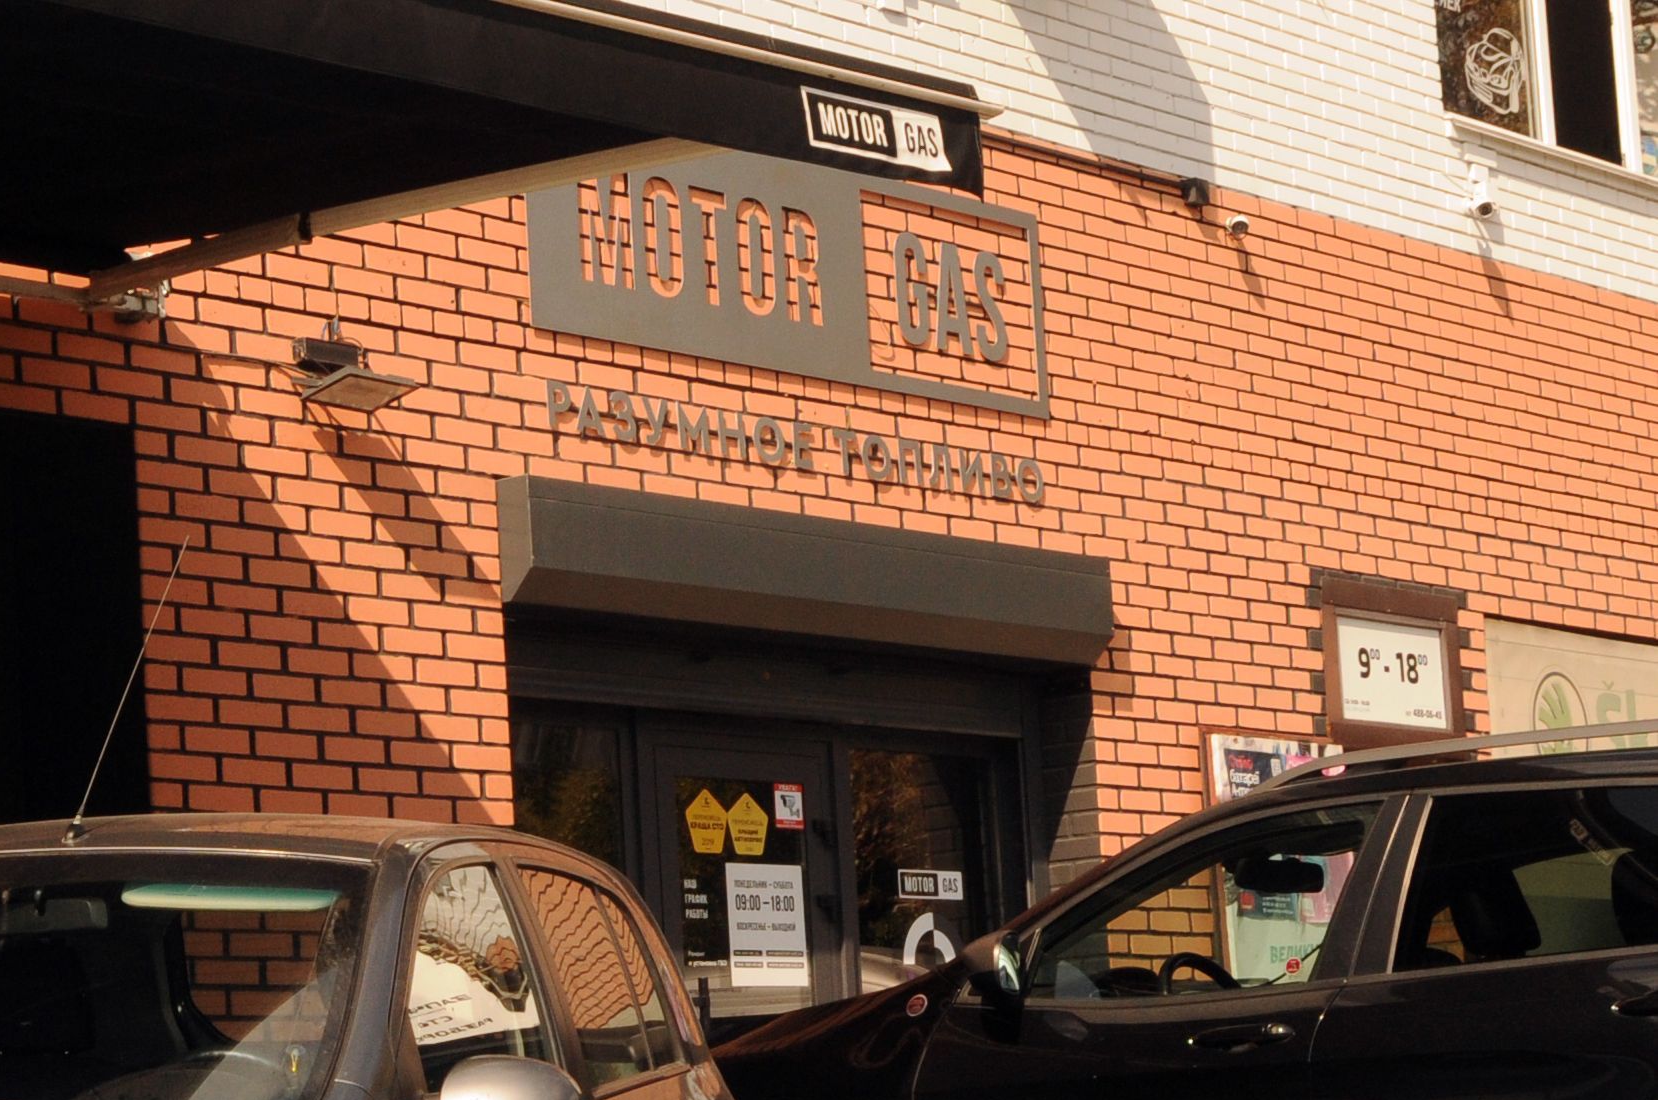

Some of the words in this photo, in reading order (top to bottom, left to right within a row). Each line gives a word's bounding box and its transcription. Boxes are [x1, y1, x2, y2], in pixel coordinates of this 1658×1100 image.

[817, 102, 888, 148] MOTOR
[904, 122, 939, 159] GAS
[576, 172, 824, 328] MOTOR
[893, 230, 1009, 363] GAS
[545, 379, 816, 469] РАЗУМНОЕ
[832, 426, 1044, 502] ТОПЛИВО
[735, 894, 761, 911] 09:00
[771, 895, 795, 912] 18:00
[904, 876, 935, 893] MOTOR
[942, 877, 959, 893] GAS
